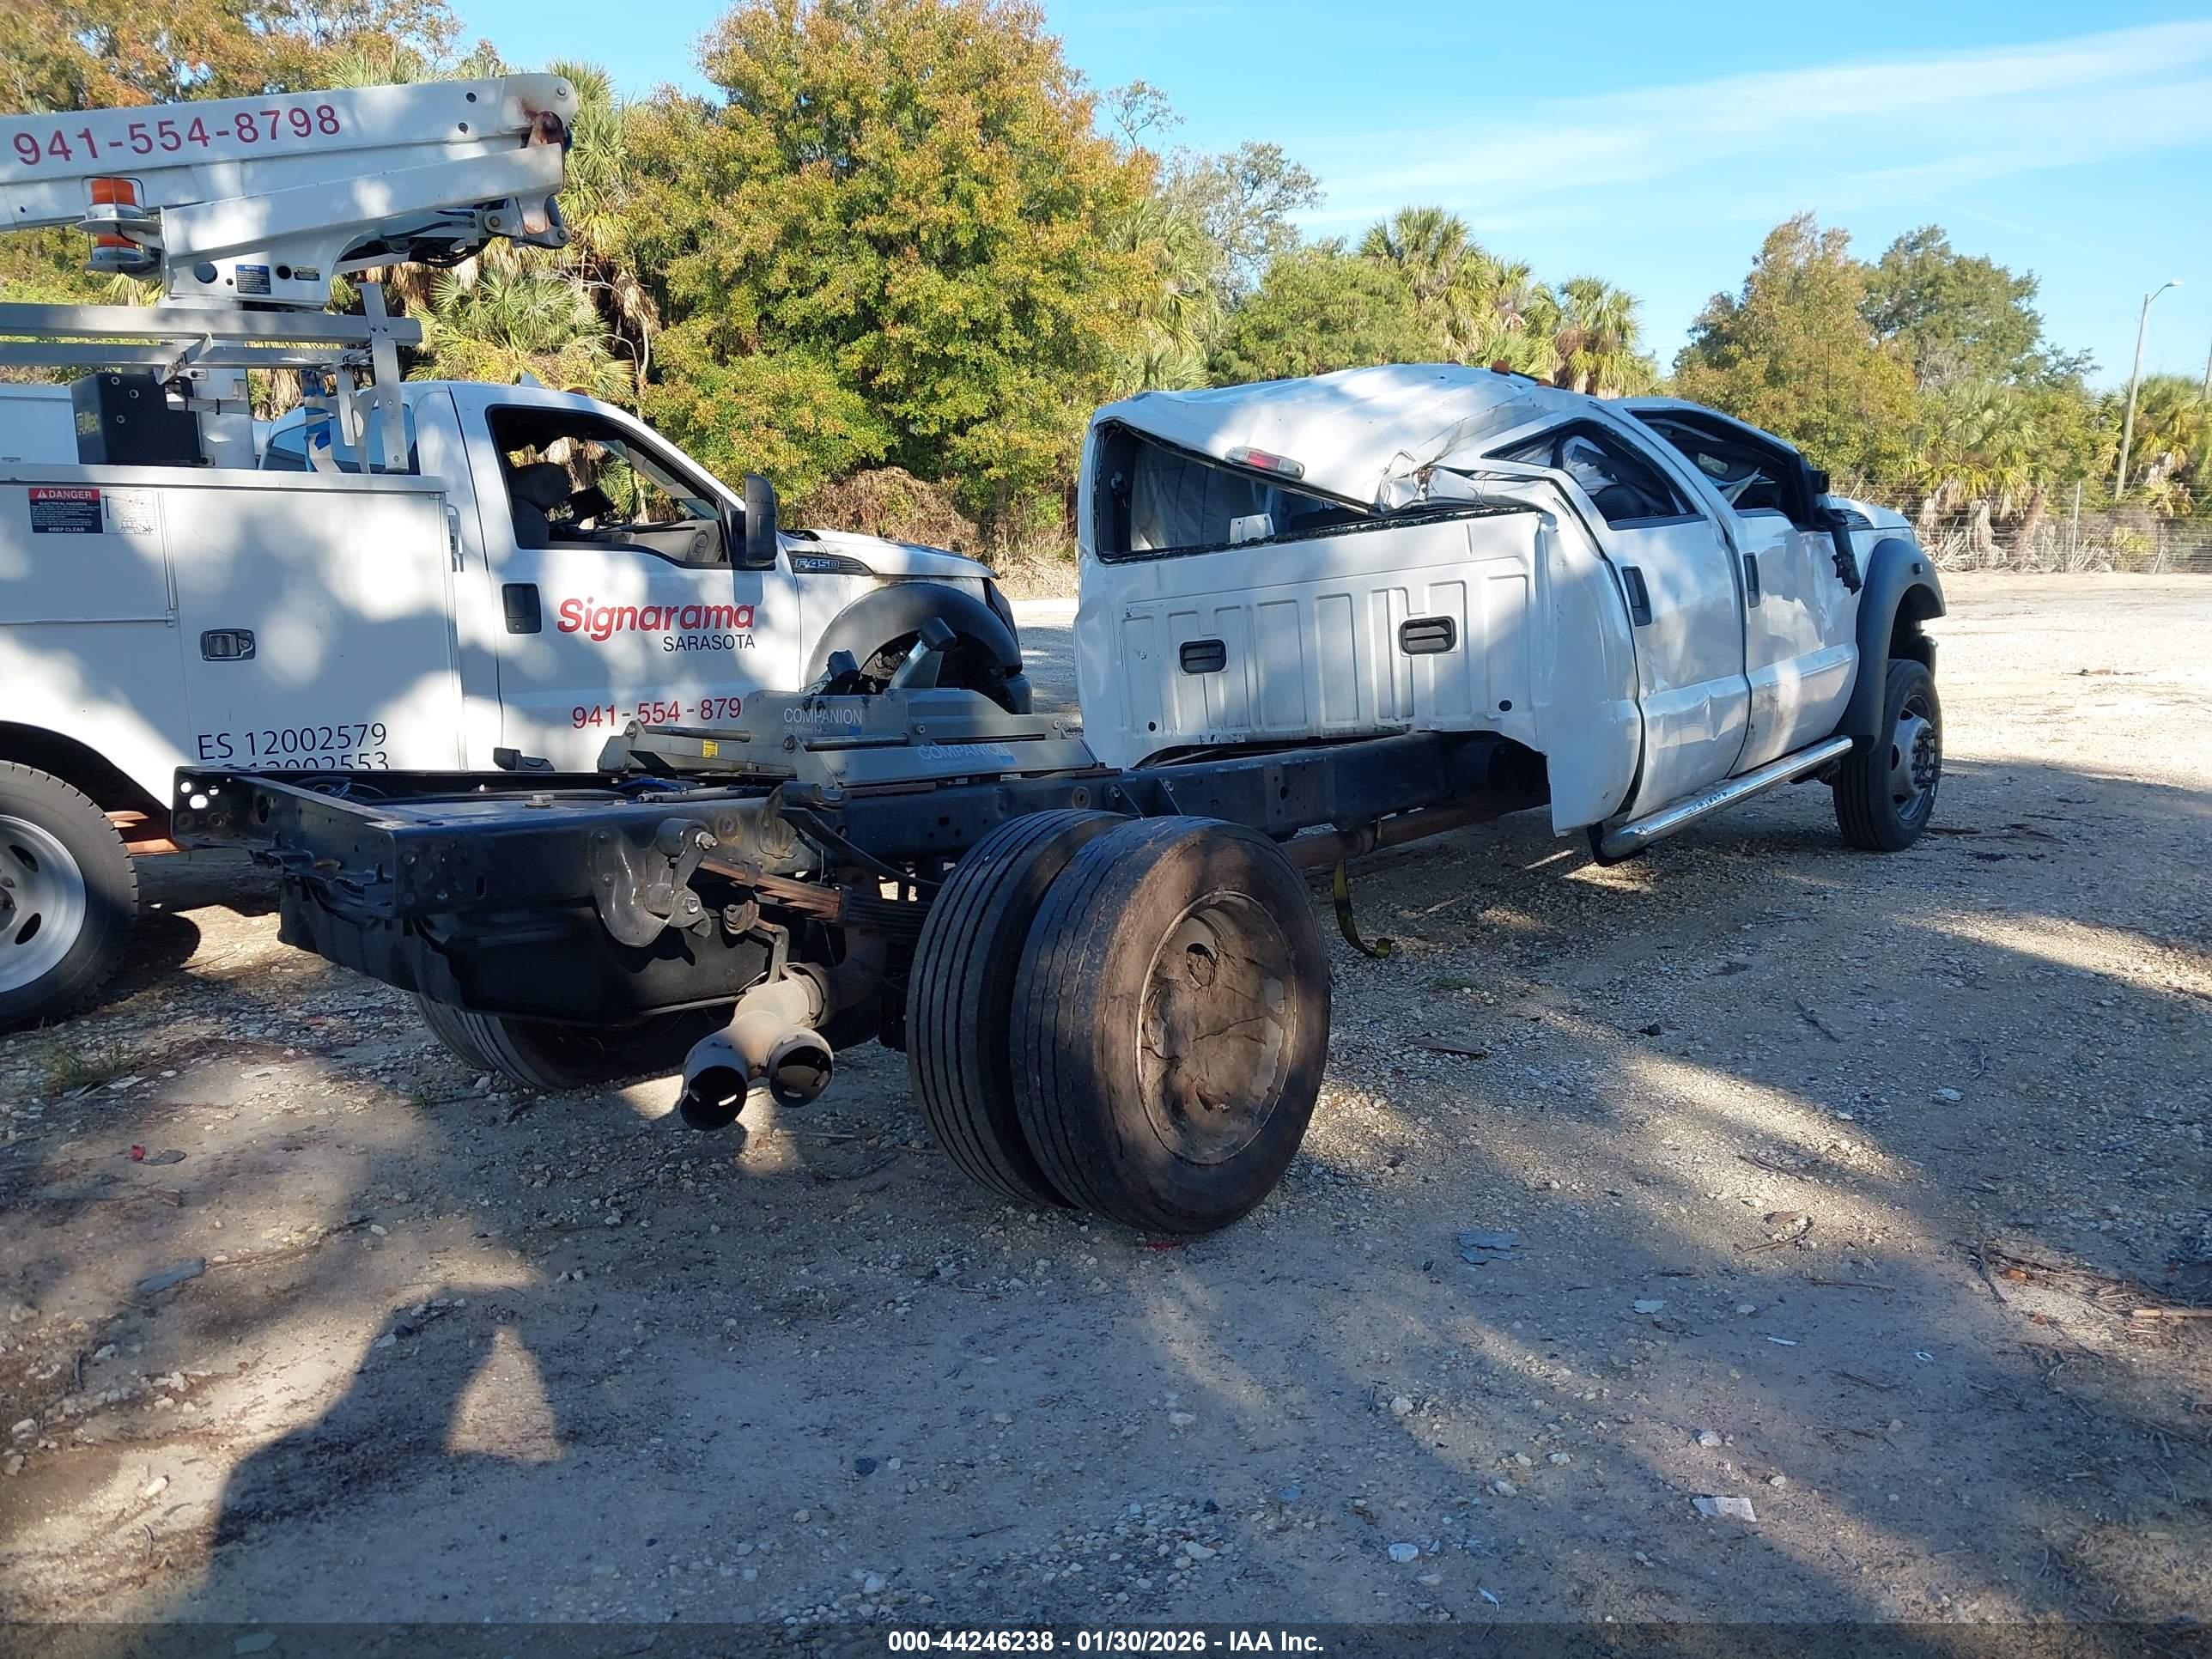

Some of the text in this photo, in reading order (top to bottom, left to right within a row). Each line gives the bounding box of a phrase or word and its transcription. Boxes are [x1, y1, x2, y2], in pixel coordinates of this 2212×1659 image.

[13, 105, 341, 165] 941-554-8798
[48, 489, 92, 499] DANGER
[557, 597, 755, 641] Signarama
[663, 634, 756, 652] SARASOTA
[783, 708, 863, 725] COMPANION
[198, 722, 387, 760] ES 12002579
[917, 741, 1012, 760] COMPANION
